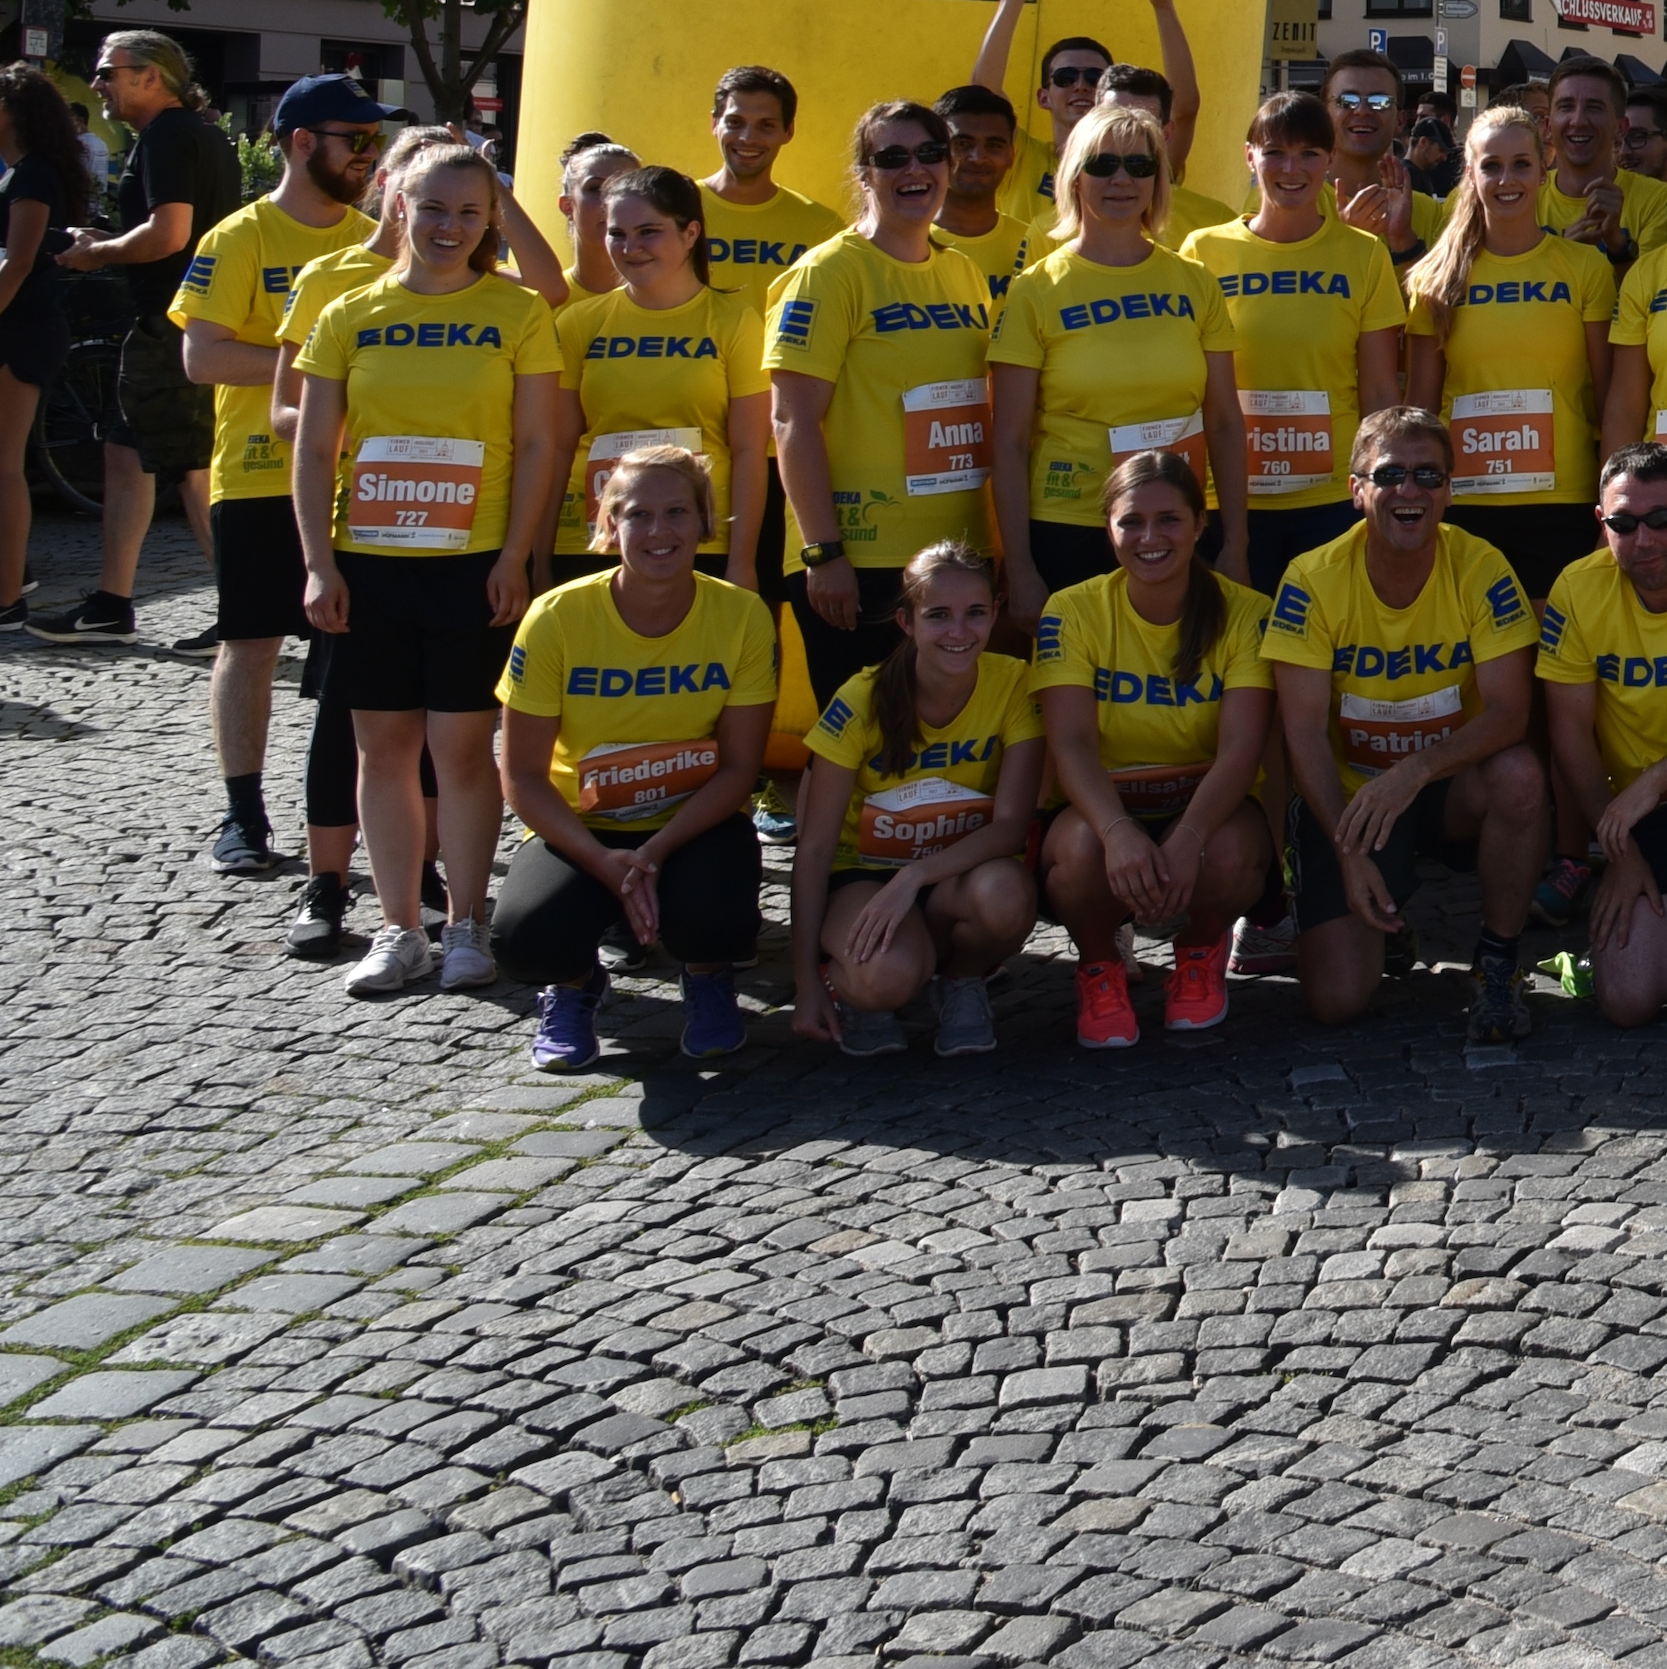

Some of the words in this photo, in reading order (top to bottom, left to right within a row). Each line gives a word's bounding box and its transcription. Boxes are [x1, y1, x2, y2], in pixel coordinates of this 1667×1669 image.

[1273, 22, 1317, 41] ZENIT
[1371, 32, 1382, 49] P
[1437, 32, 1445, 50] P
[706, 239, 809, 265] DEKA
[1220, 270, 1351, 299] EDEKA
[1059, 294, 1195, 331] EDEKA
[357, 324, 502, 349] EDEKA
[585, 336, 718, 360] EDEKA
[932, 390, 948, 399] LAUF
[928, 421, 983, 449] Anna
[1143, 431, 1163, 440] LAUF
[1245, 427, 1330, 452] ristina
[1462, 425, 1540, 453] Sarah
[243, 458, 284, 472] gesund
[949, 454, 974, 470] 773
[1262, 460, 1291, 475] 760
[1486, 459, 1514, 474] 751
[358, 473, 475, 504] Simone
[1044, 487, 1082, 499] gesund
[396, 511, 428, 526] 727
[1274, 584, 1311, 625] E
[1495, 609, 1527, 628] EDEKA
[1333, 641, 1472, 680] EDEKA
[566, 663, 731, 698] EDEKA
[584, 747, 716, 789] Friederike
[633, 785, 667, 806] 801
[873, 808, 985, 846] Sophie
